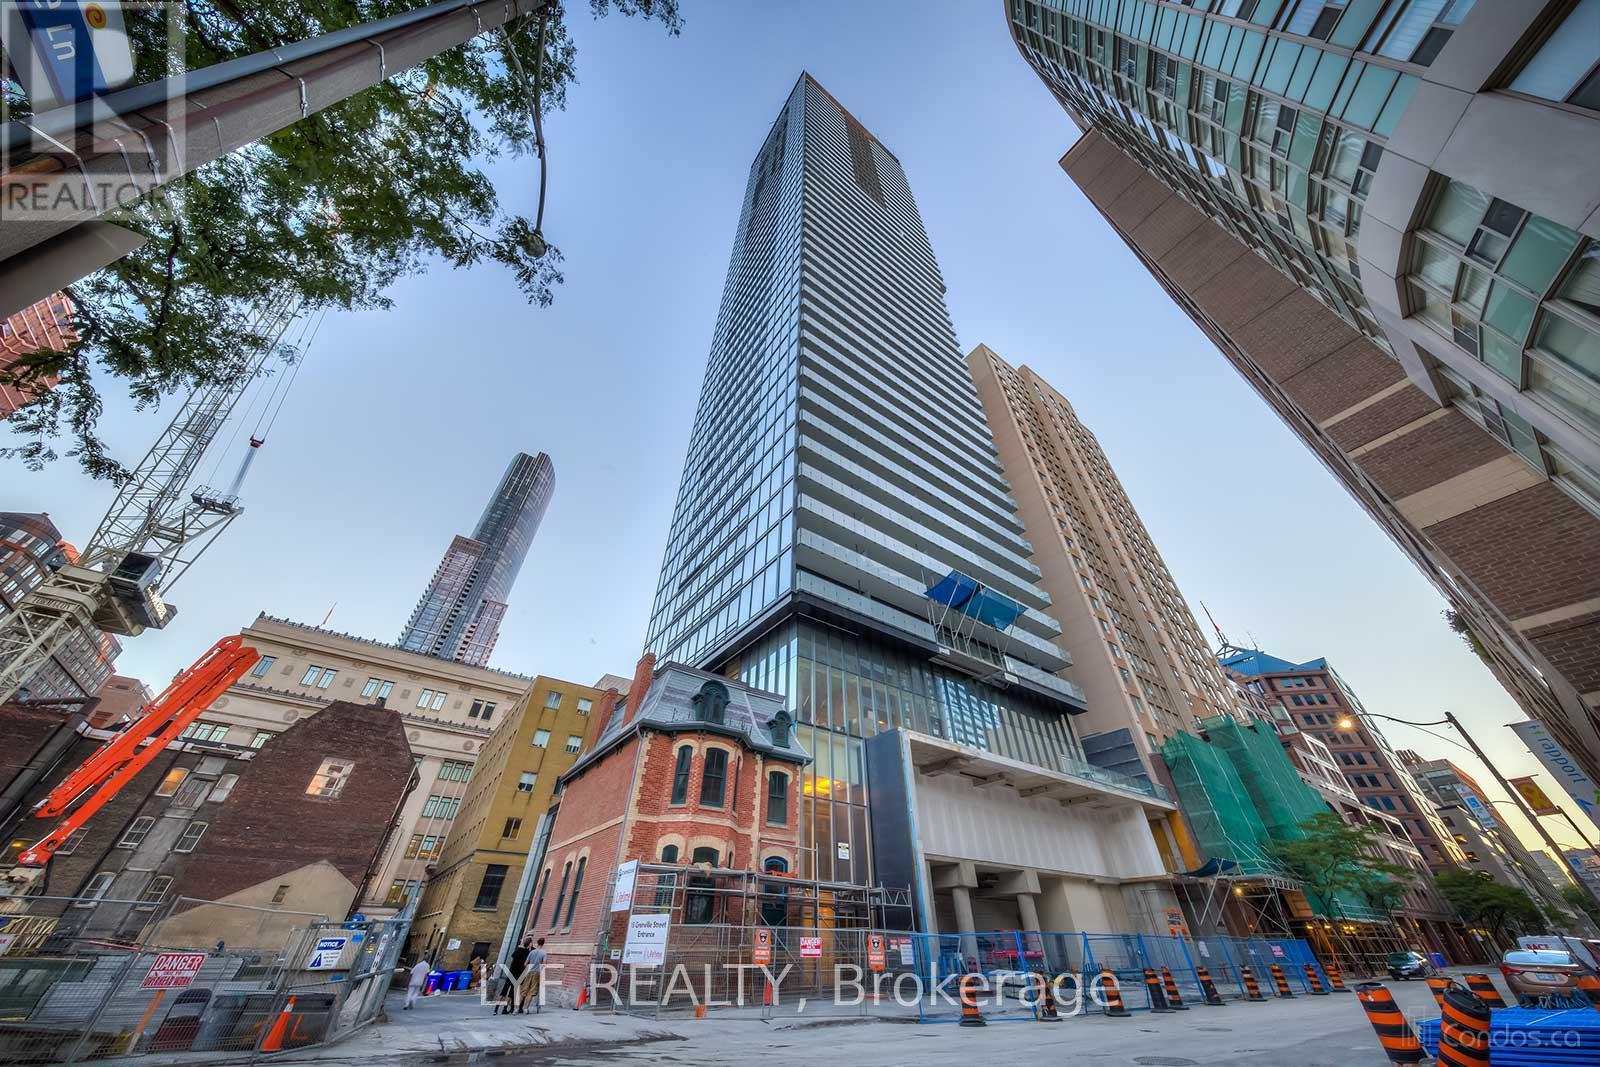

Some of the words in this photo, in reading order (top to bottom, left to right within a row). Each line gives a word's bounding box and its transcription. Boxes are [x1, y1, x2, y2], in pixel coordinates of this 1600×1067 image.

[1538, 737, 1587, 783] rapport
[653, 920, 667, 929] Street
[637, 930, 655, 938] Entrance
[153, 955, 203, 970] DANGER
